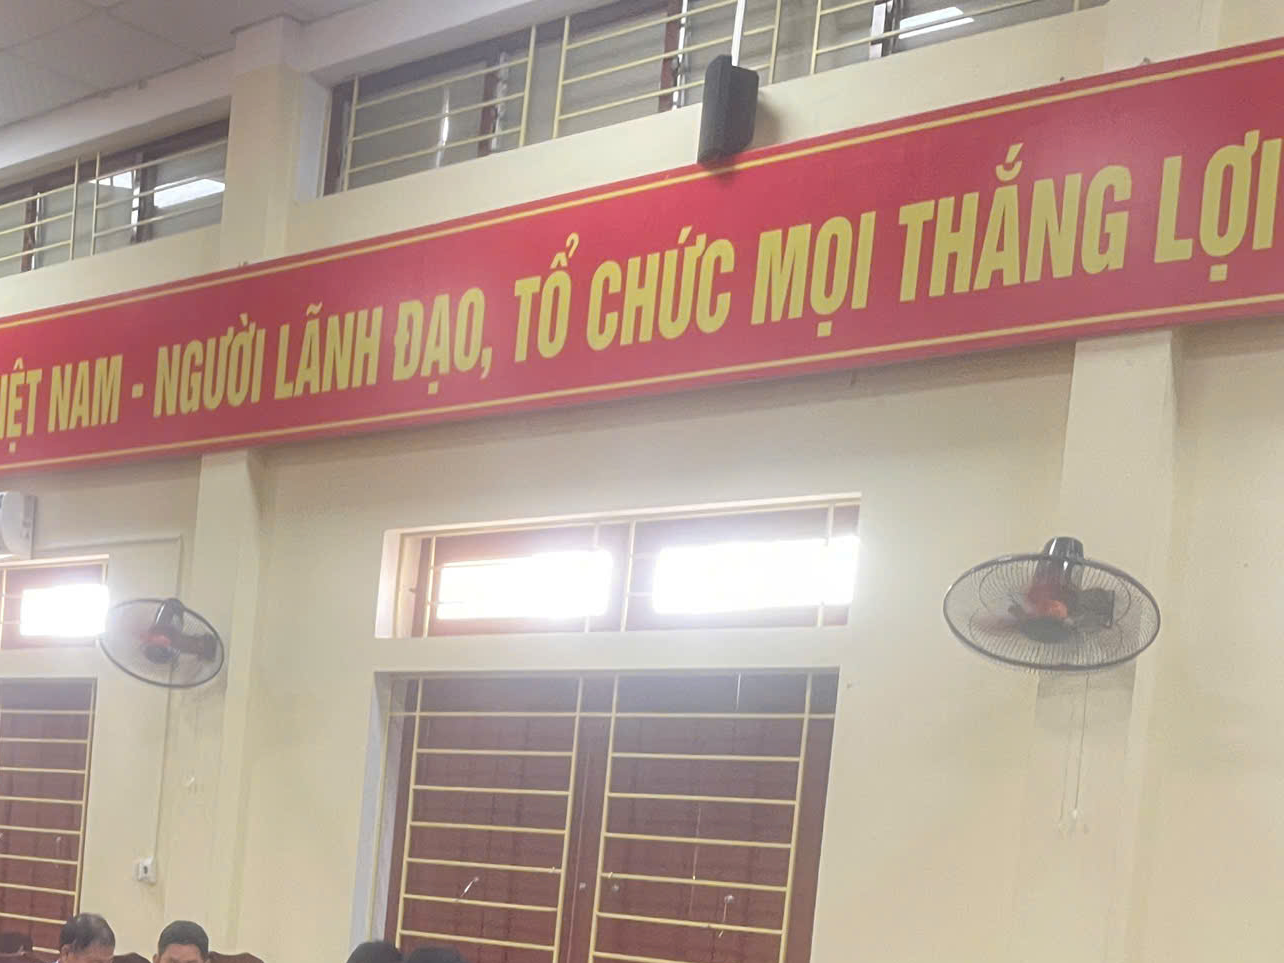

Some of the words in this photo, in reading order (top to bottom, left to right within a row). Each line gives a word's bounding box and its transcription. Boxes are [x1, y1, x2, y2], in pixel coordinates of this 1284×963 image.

[48, 354, 123, 431] NAM
[153, 312, 267, 418] NGƯỜI
[274, 301, 384, 400] LÃNH
[394, 287, 493, 396] ĐẠO,
[513, 231, 581, 362] TỔ
[586, 225, 736, 350] CHỨC
[750, 211, 876, 339] MỌI
[898, 143, 1133, 303] THẮNG
[1154, 129, 1283, 283] LỢI
